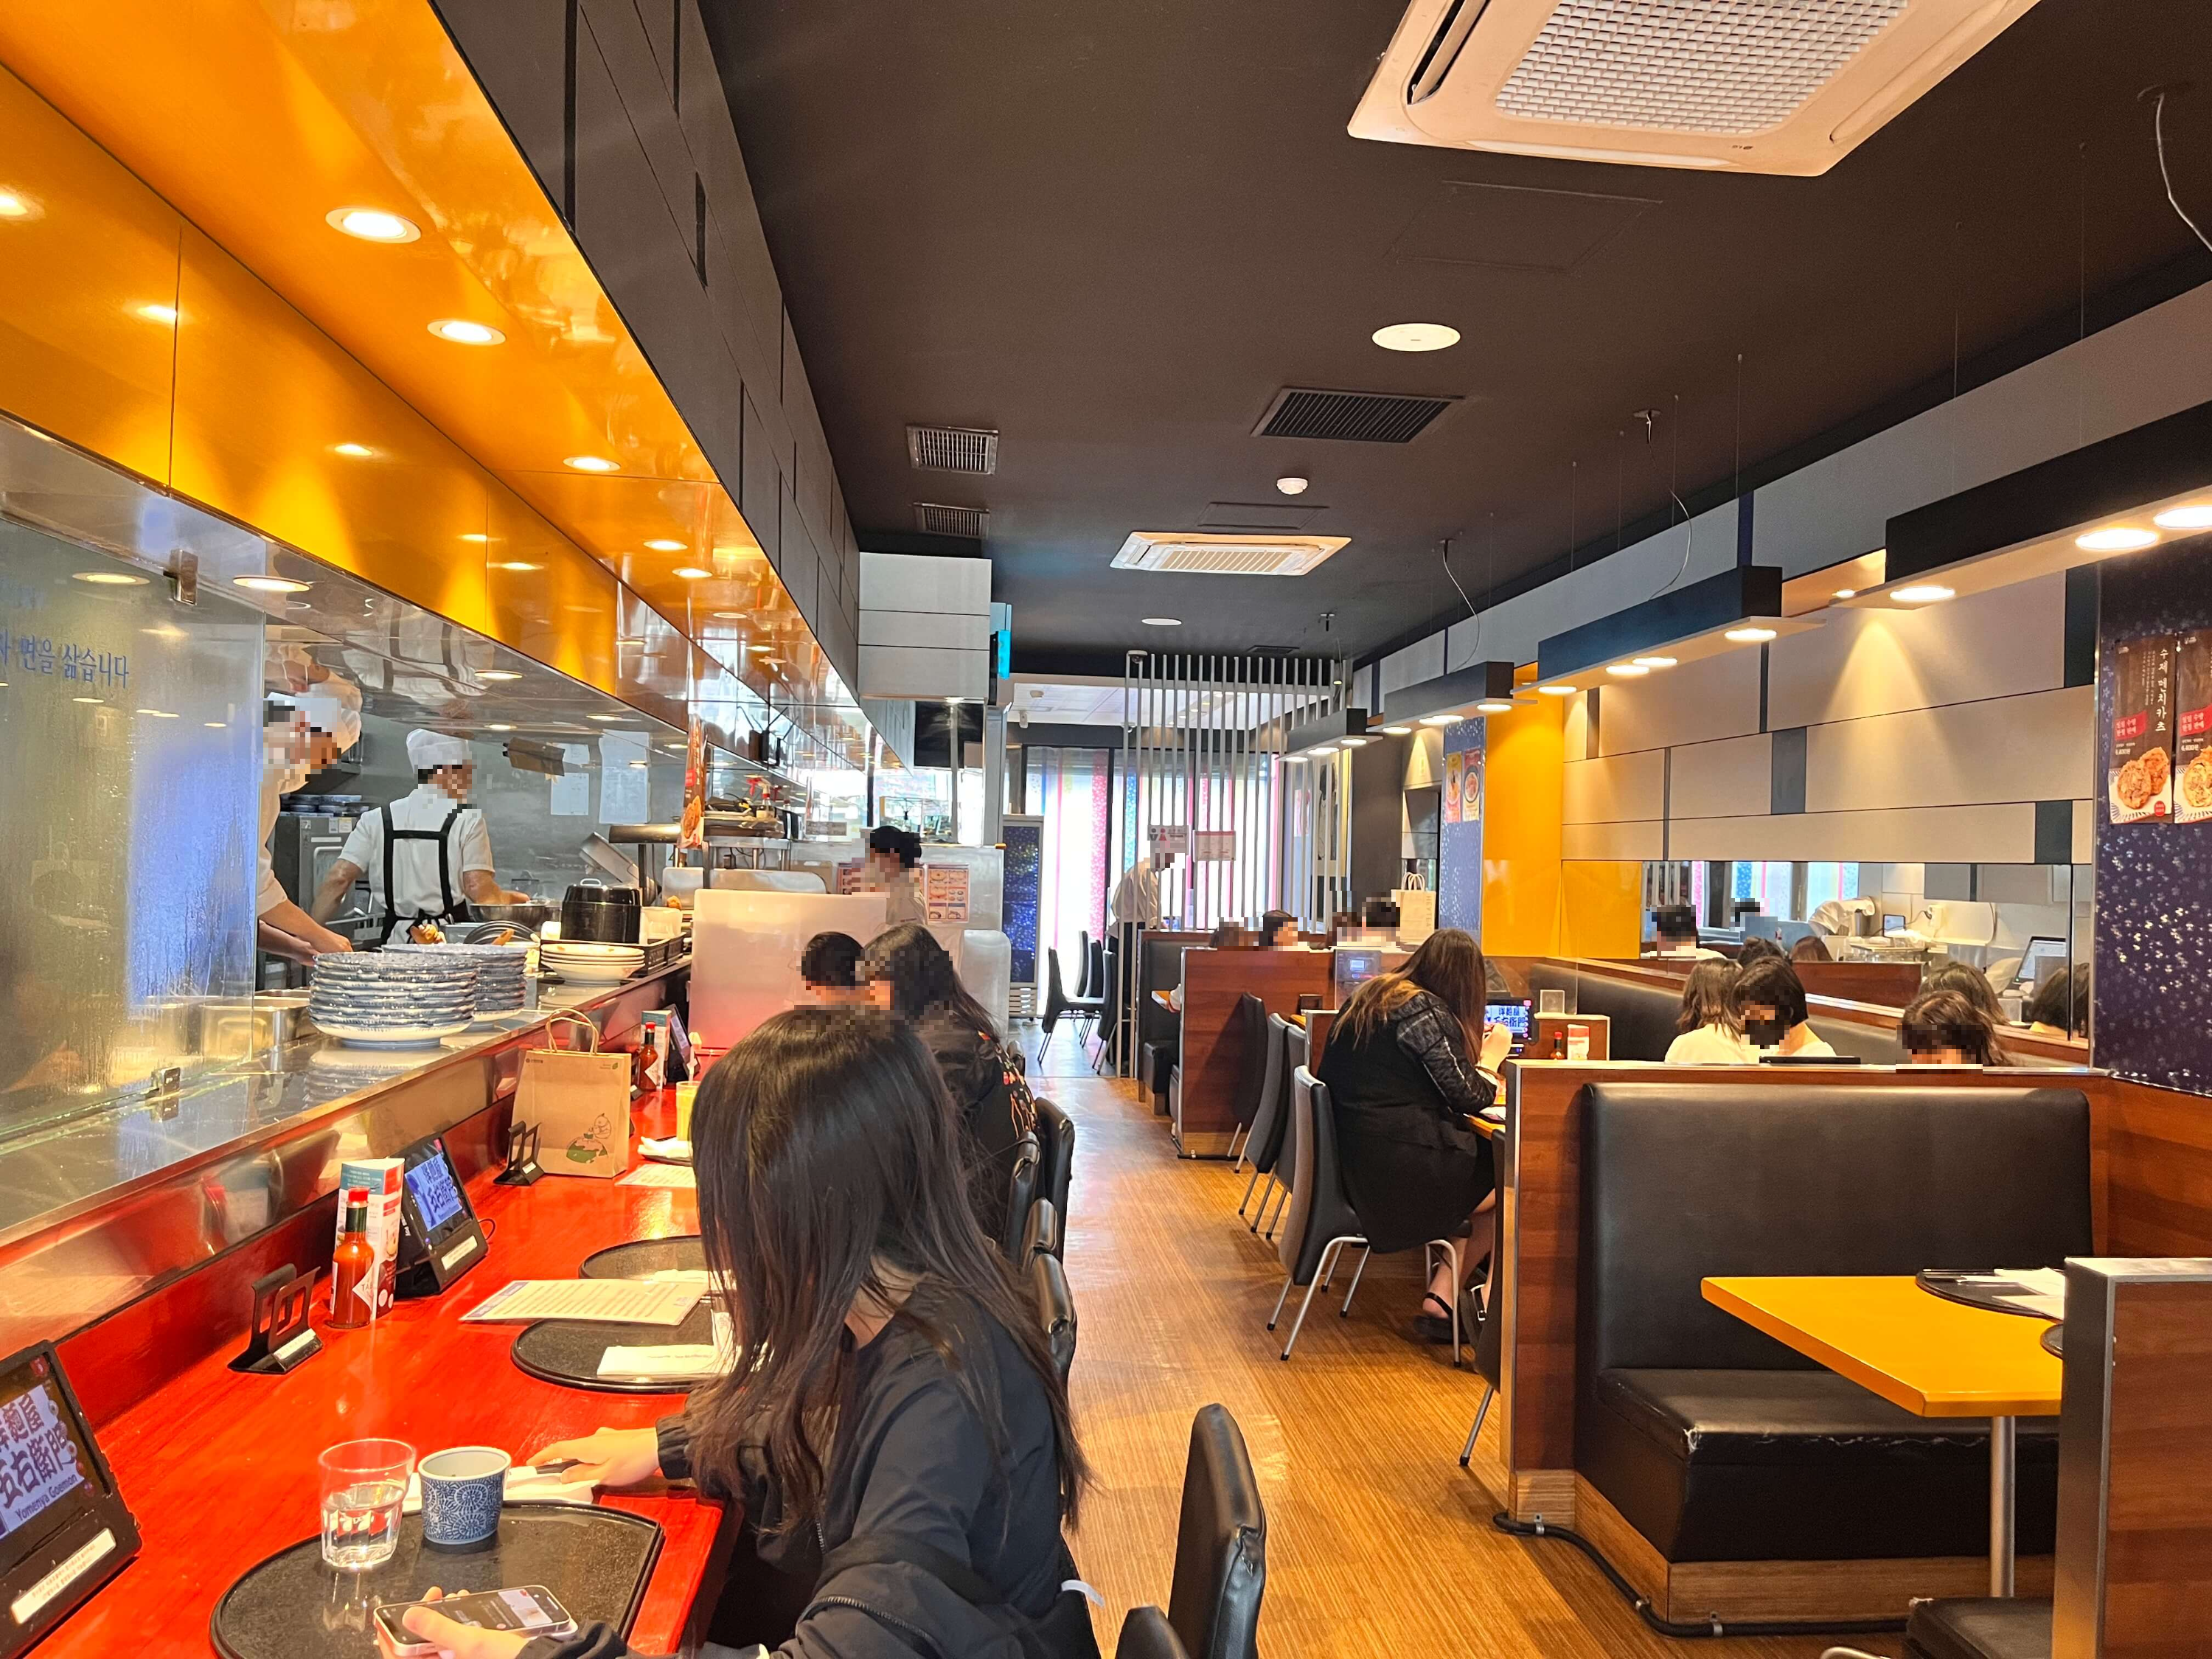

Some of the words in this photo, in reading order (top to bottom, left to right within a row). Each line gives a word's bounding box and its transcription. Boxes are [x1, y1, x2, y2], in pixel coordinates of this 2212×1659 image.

[21, 635, 56, 675] 면을
[62, 643, 130, 689] 삶습니다
[2157, 649, 2168, 674] 수제
[2155, 678, 2168, 732] 멘치카츠
[15, 1493, 50, 1521] Yomenya
[48, 1473, 78, 1498] Goemon
